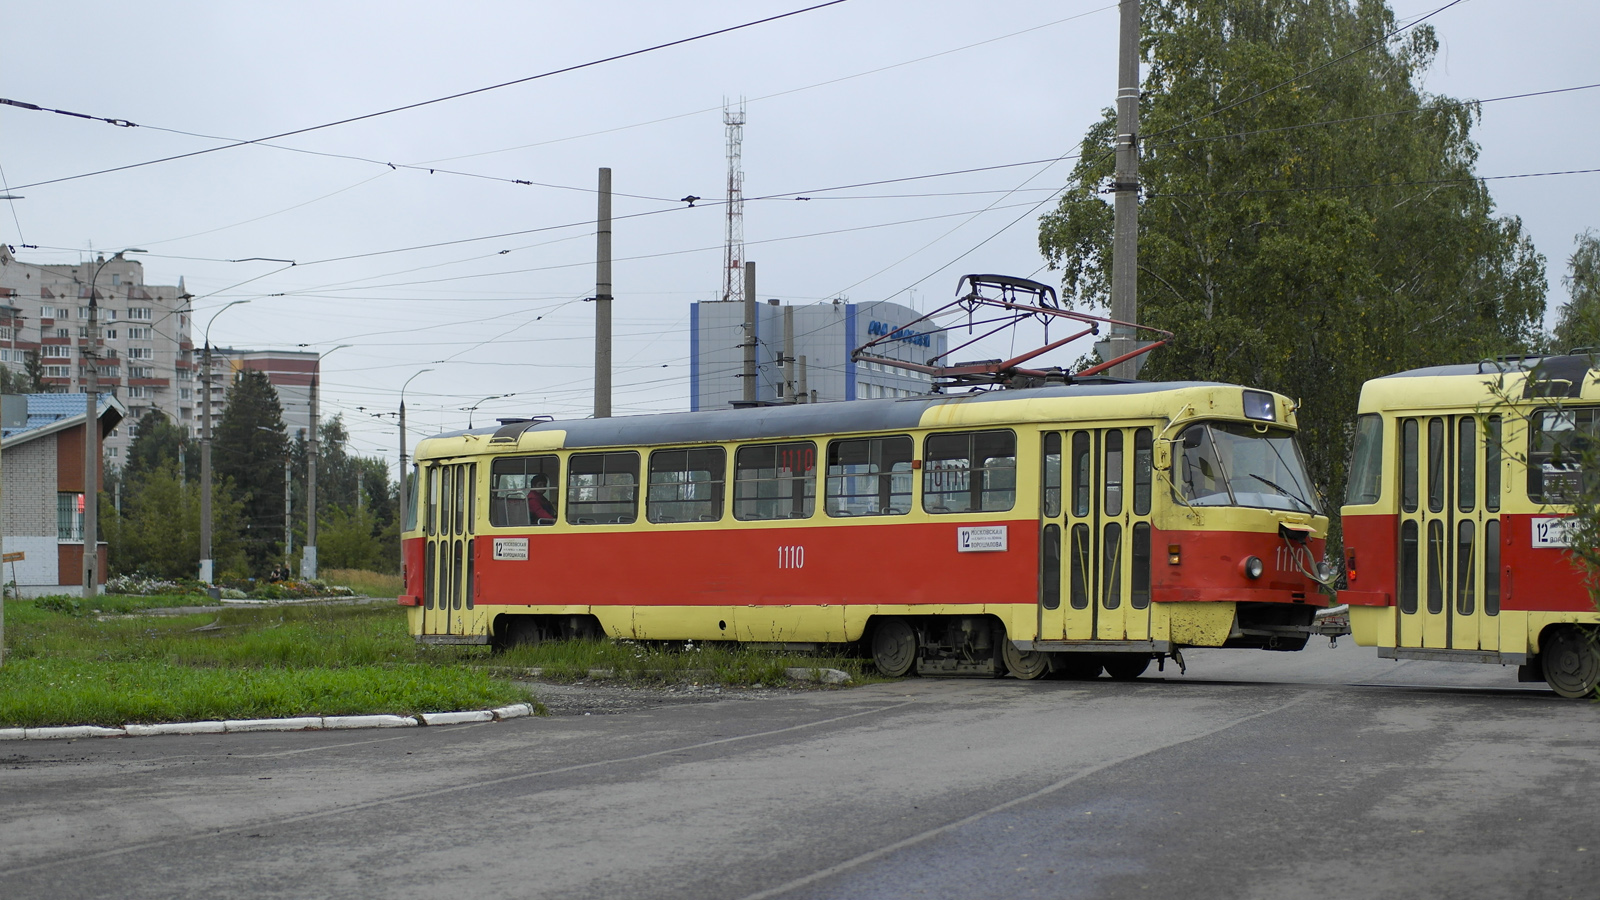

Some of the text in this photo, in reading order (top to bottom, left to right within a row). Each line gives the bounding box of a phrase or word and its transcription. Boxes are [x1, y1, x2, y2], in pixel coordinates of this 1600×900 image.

[782, 448, 813, 472] 1110
[962, 531, 970, 547] 12
[1537, 523, 1548, 542] 12
[496, 542, 502, 556] 12
[777, 545, 804, 569] 1110
[1276, 546, 1304, 572] 1110
